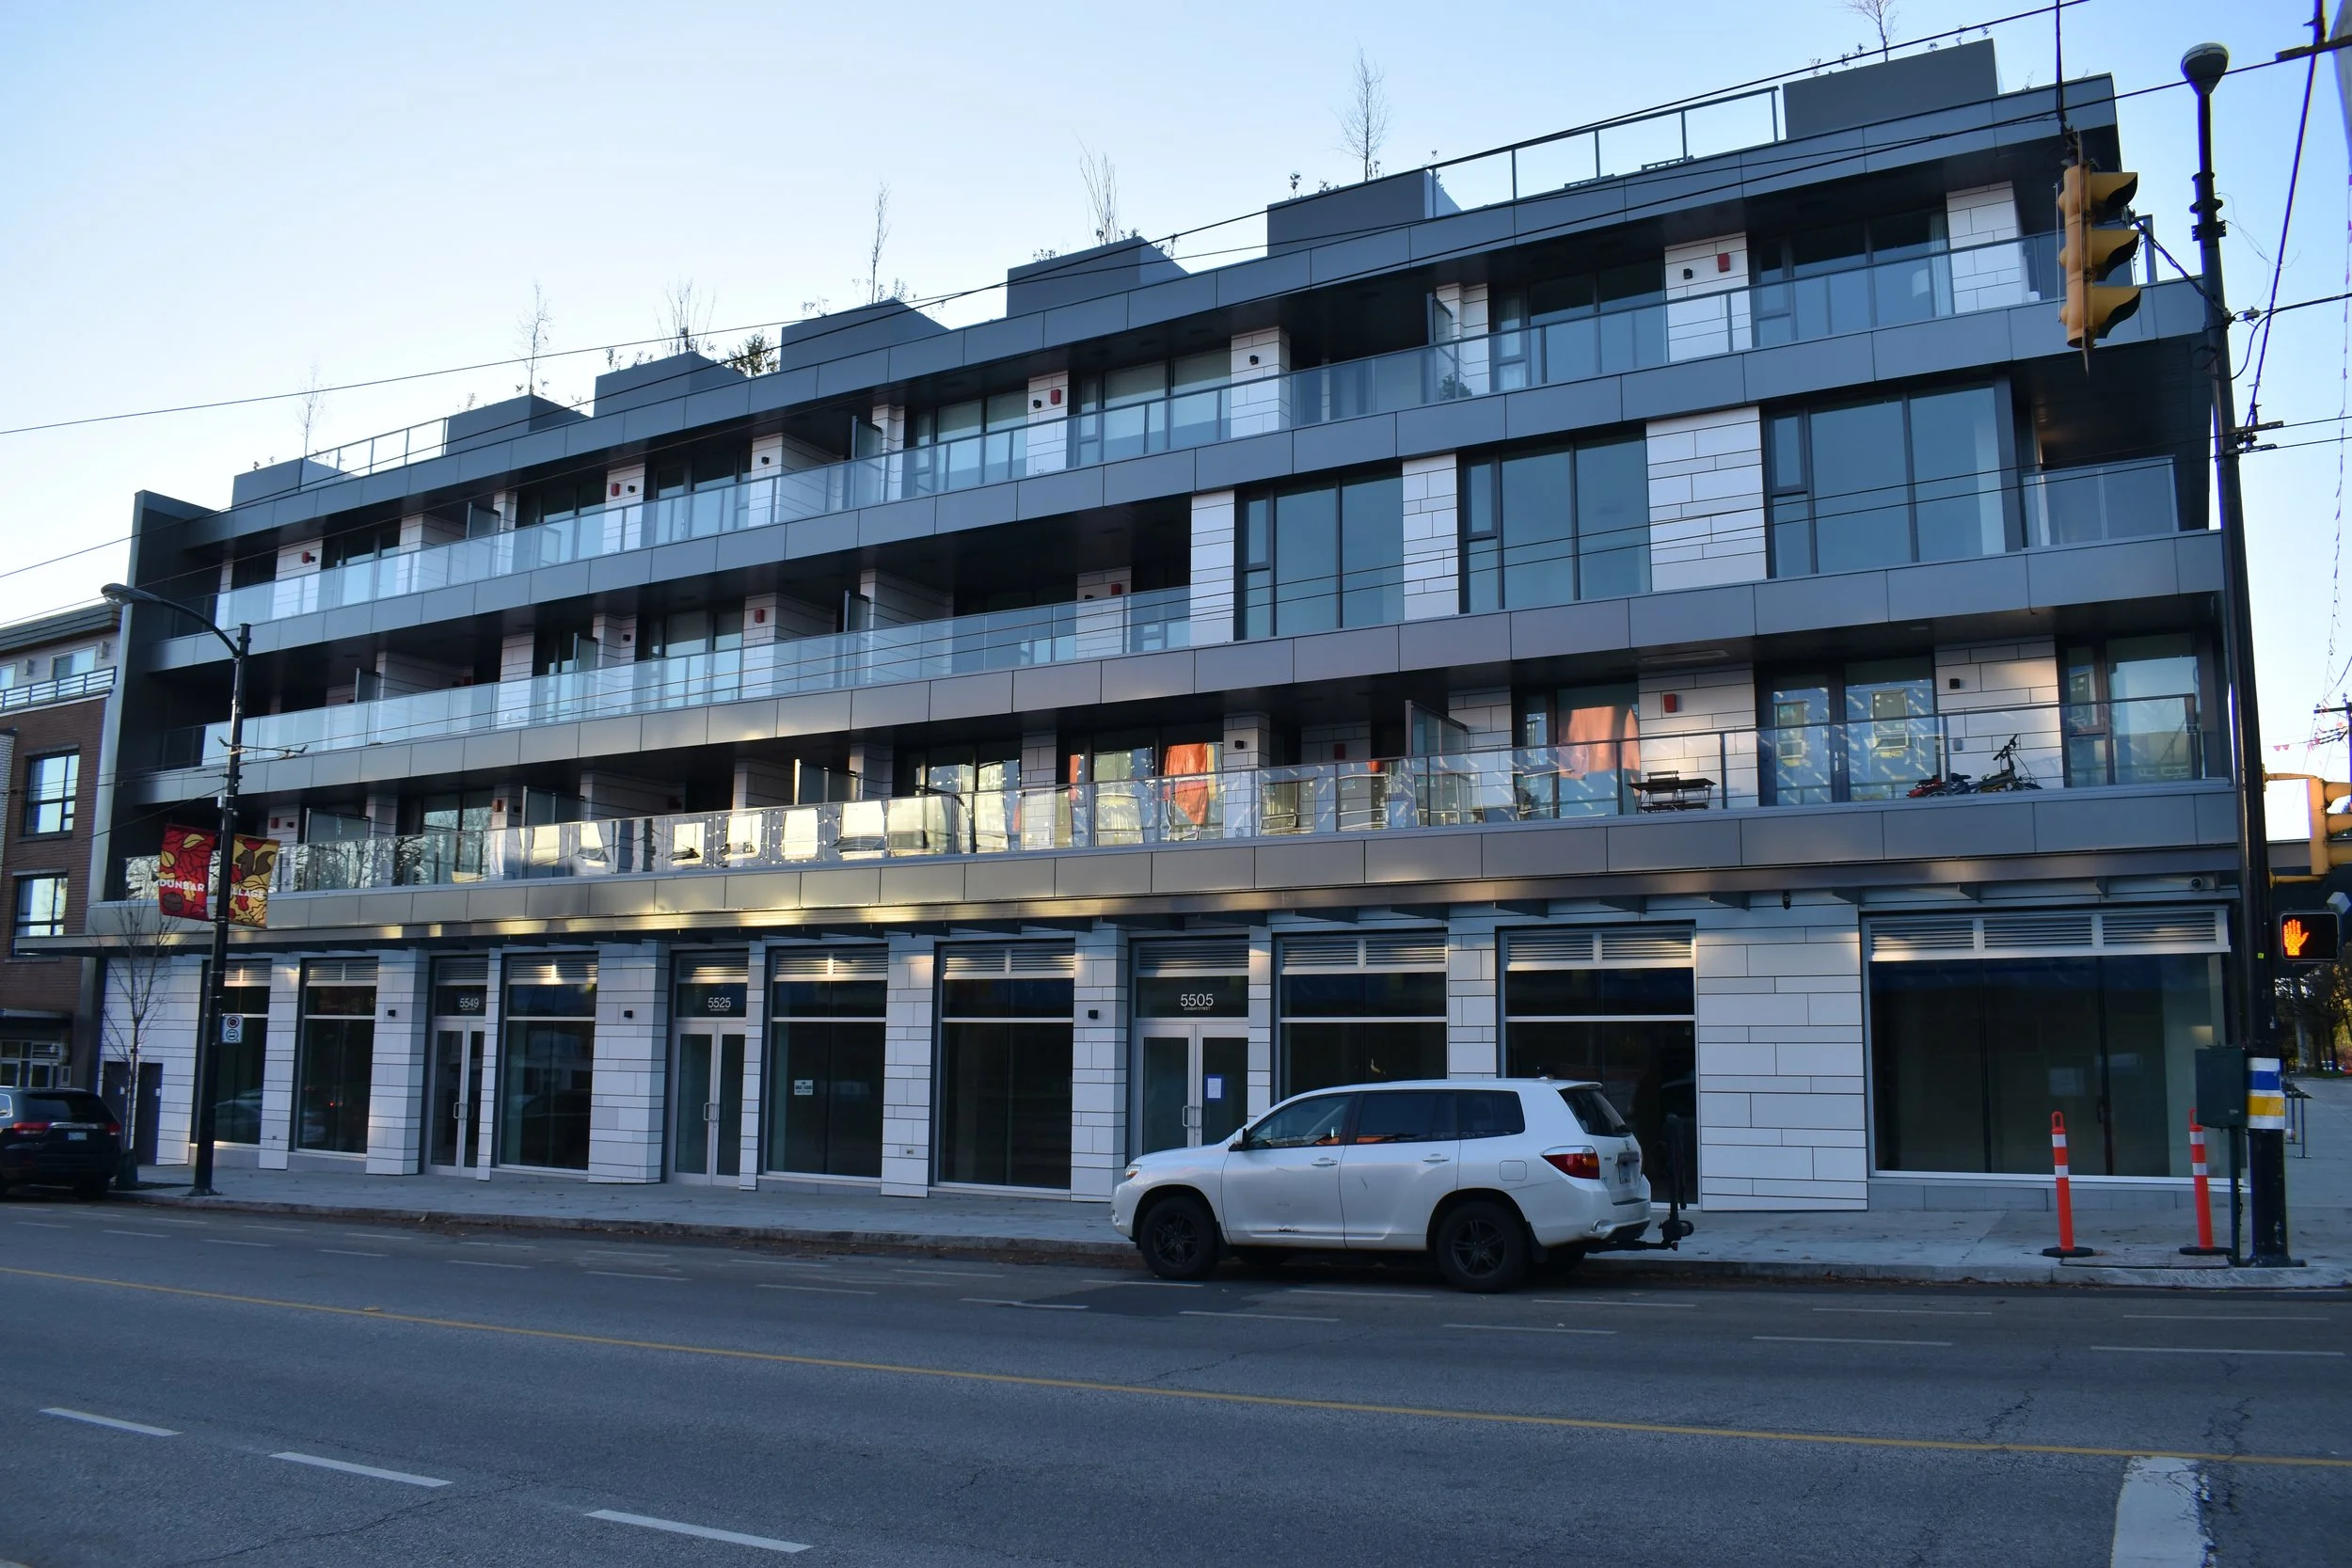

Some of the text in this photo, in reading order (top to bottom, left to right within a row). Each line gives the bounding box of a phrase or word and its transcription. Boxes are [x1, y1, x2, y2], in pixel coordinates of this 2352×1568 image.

[159, 879, 205, 893] DUNBAR
[459, 997, 480, 1008] 5549
[707, 997, 732, 1008] 5525
[1180, 993, 1214, 1006] 5505
